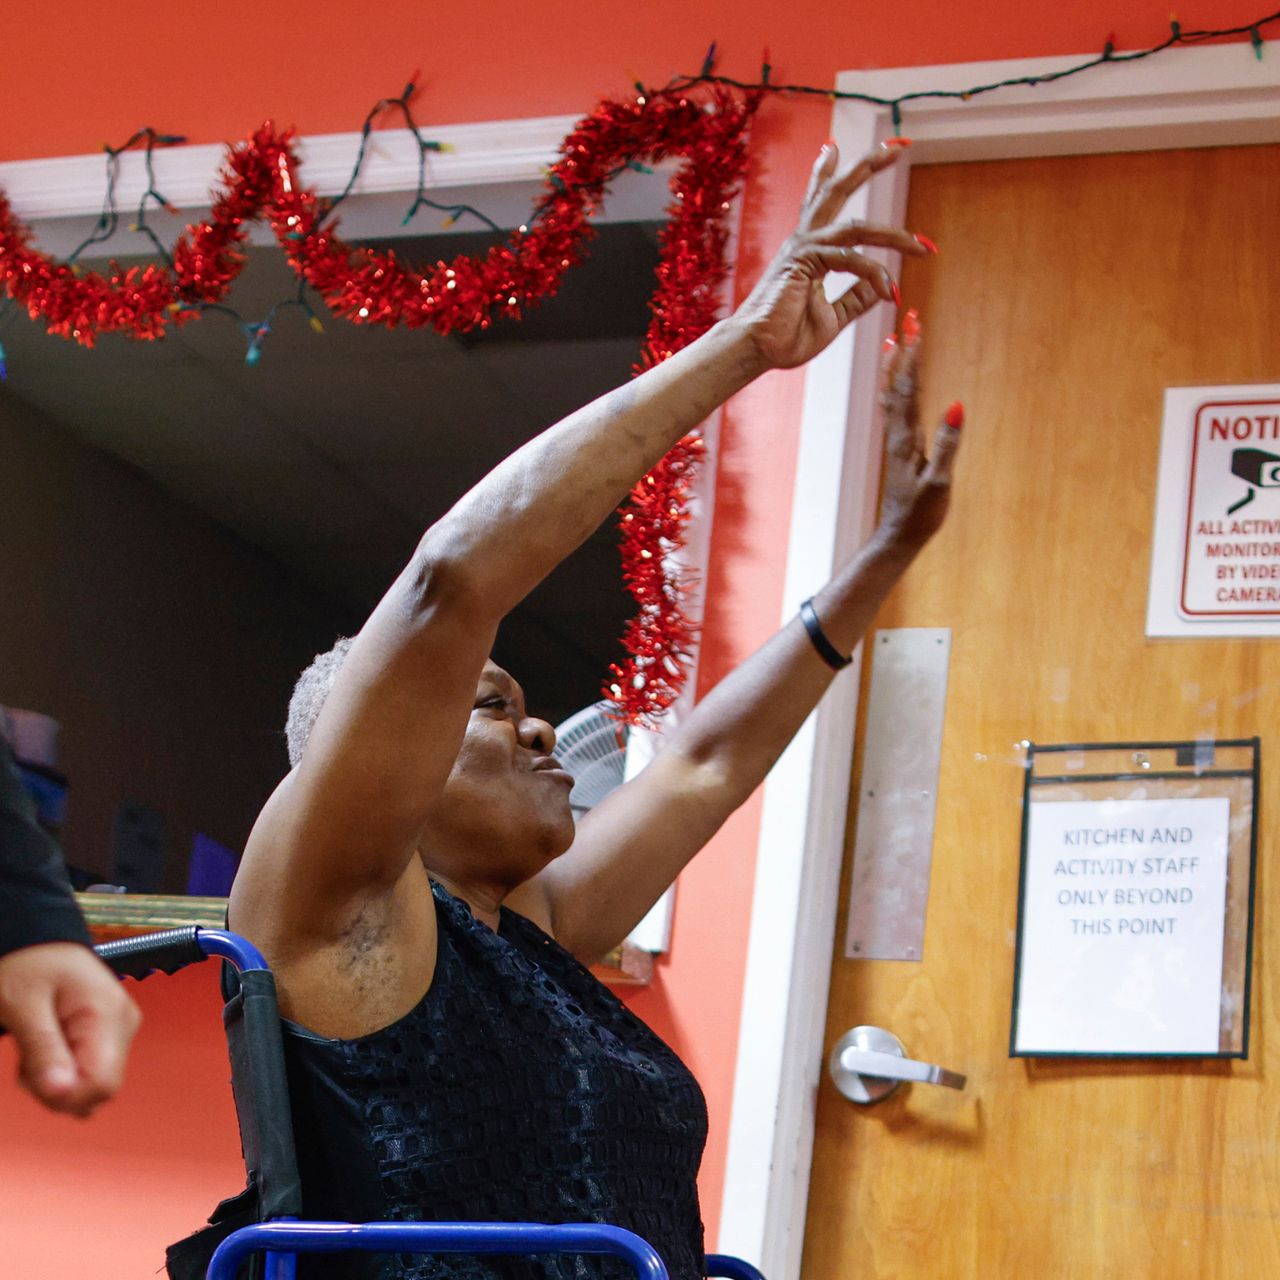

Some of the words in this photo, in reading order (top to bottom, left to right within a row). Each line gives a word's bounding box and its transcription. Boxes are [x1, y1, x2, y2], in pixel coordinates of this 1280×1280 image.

[1196, 520, 1224, 536] ALL
[1216, 564, 1237, 580] BY
[1064, 828, 1145, 847] KITCHEN
[1151, 826, 1194, 845] AND
[1054, 858, 1138, 877] ACTIVITY
[1143, 856, 1201, 875] STAFF
[1057, 889, 1109, 907] ONLY
[1114, 887, 1194, 906] BEYOND
[1070, 918, 1113, 936] THIS
[1118, 916, 1178, 936] POINT
